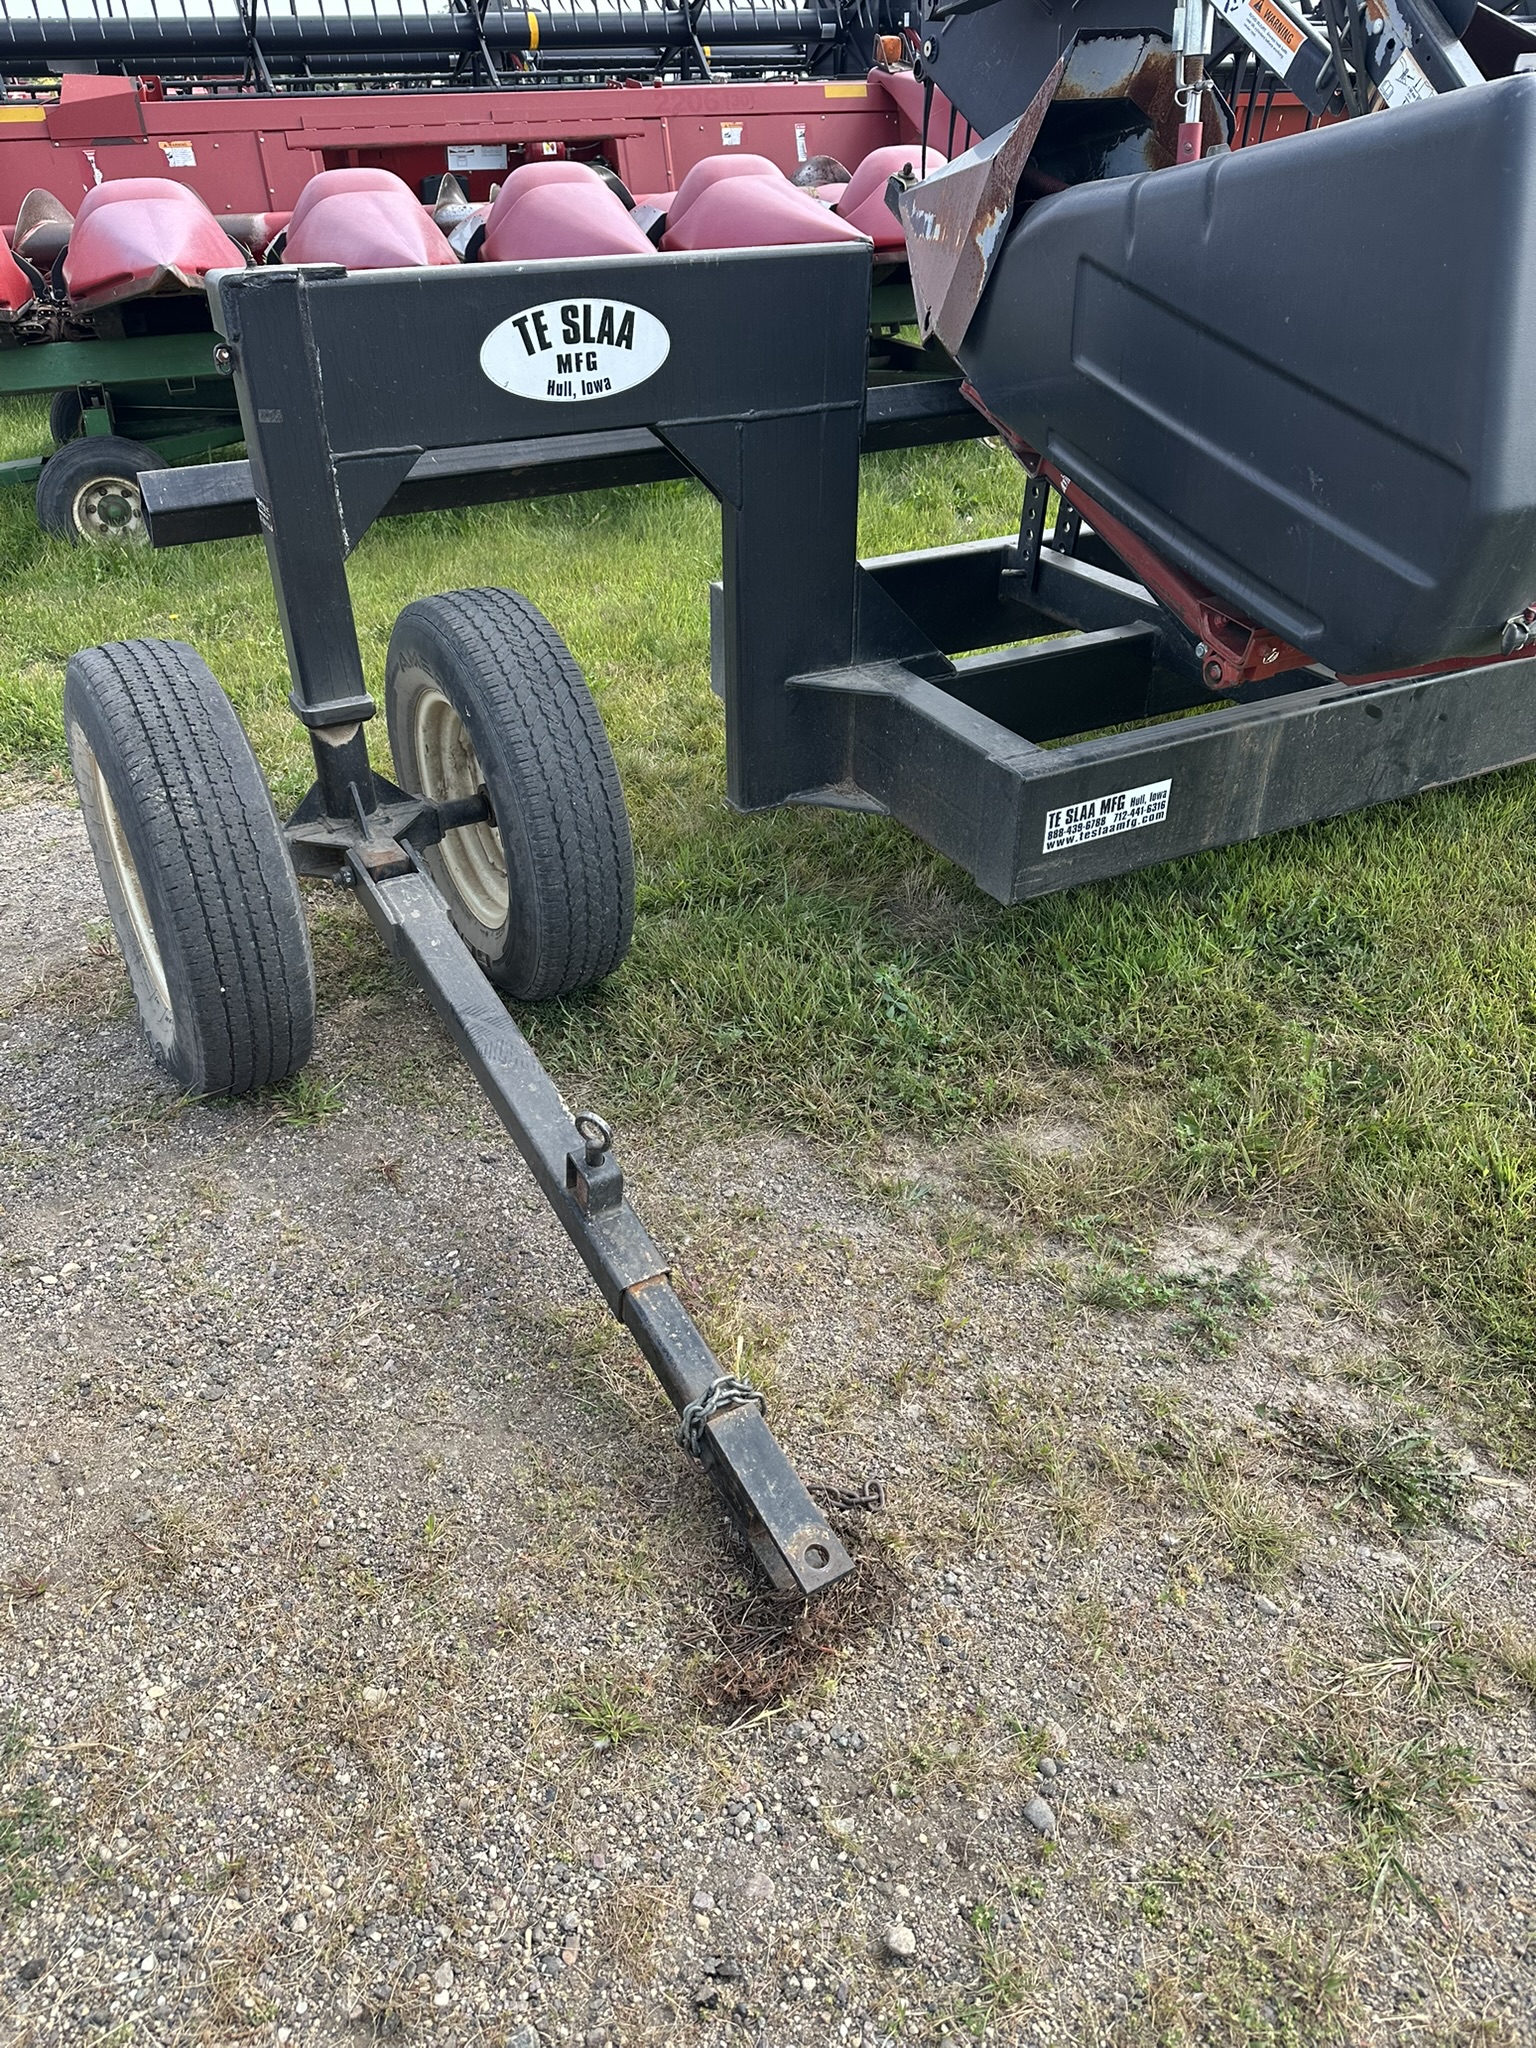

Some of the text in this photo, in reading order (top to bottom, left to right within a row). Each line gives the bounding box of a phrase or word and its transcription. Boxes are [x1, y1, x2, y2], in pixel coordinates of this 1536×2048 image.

[1263, 8, 1294, 44] WARNING
[512, 304, 636, 356] TE SLAA
[556, 351, 598, 374] MFG
[547, 377, 612, 399] Hull, Iowa
[1047, 800, 1166, 841] 888-439-6788 712-441-6316
[1048, 789, 1167, 829] TE SLAA MFG Hull, Iowa
[1046, 810, 1165, 848] www.teslaamfg.com
